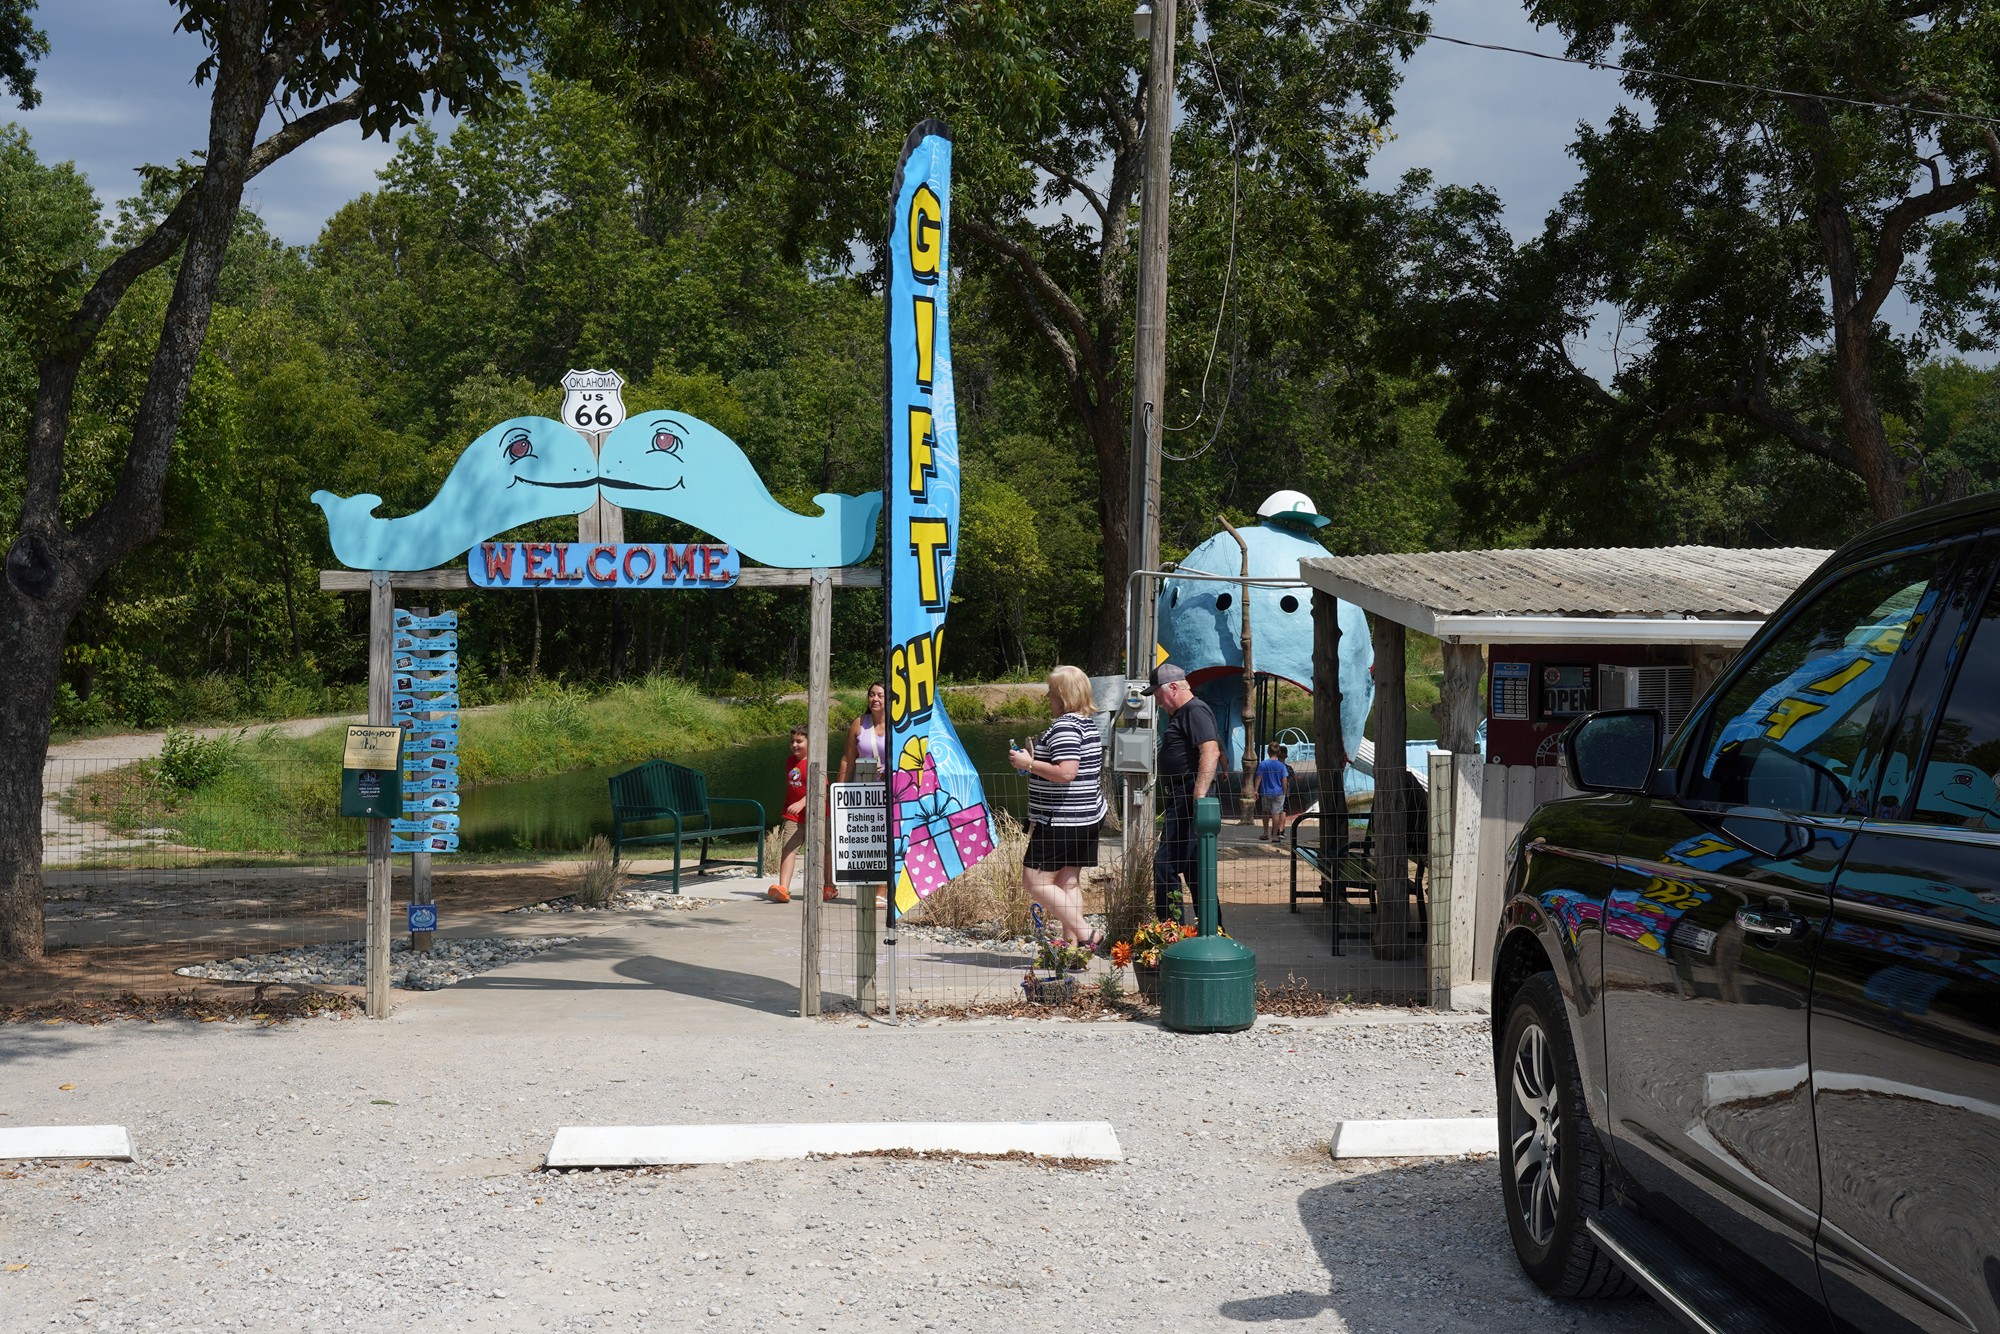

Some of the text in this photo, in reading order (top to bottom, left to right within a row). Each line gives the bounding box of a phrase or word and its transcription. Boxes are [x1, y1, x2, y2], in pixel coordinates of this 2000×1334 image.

[569, 377, 616, 388] OKLAHOMA
[582, 393, 604, 401] US
[908, 182, 951, 612] GIFT
[575, 404, 613, 426] 66
[481, 542, 730, 582] WELCOME
[890, 624, 945, 730] SH
[1544, 689, 1592, 712] OPEN
[837, 790, 887, 807] POND RULE
[847, 813, 884, 823] Fishing is
[846, 824, 885, 833] Catch and
[839, 834, 887, 844] Release ONL
[838, 850, 888, 859] NO SWIMMIN
[847, 861, 886, 870] ALLOWED!
